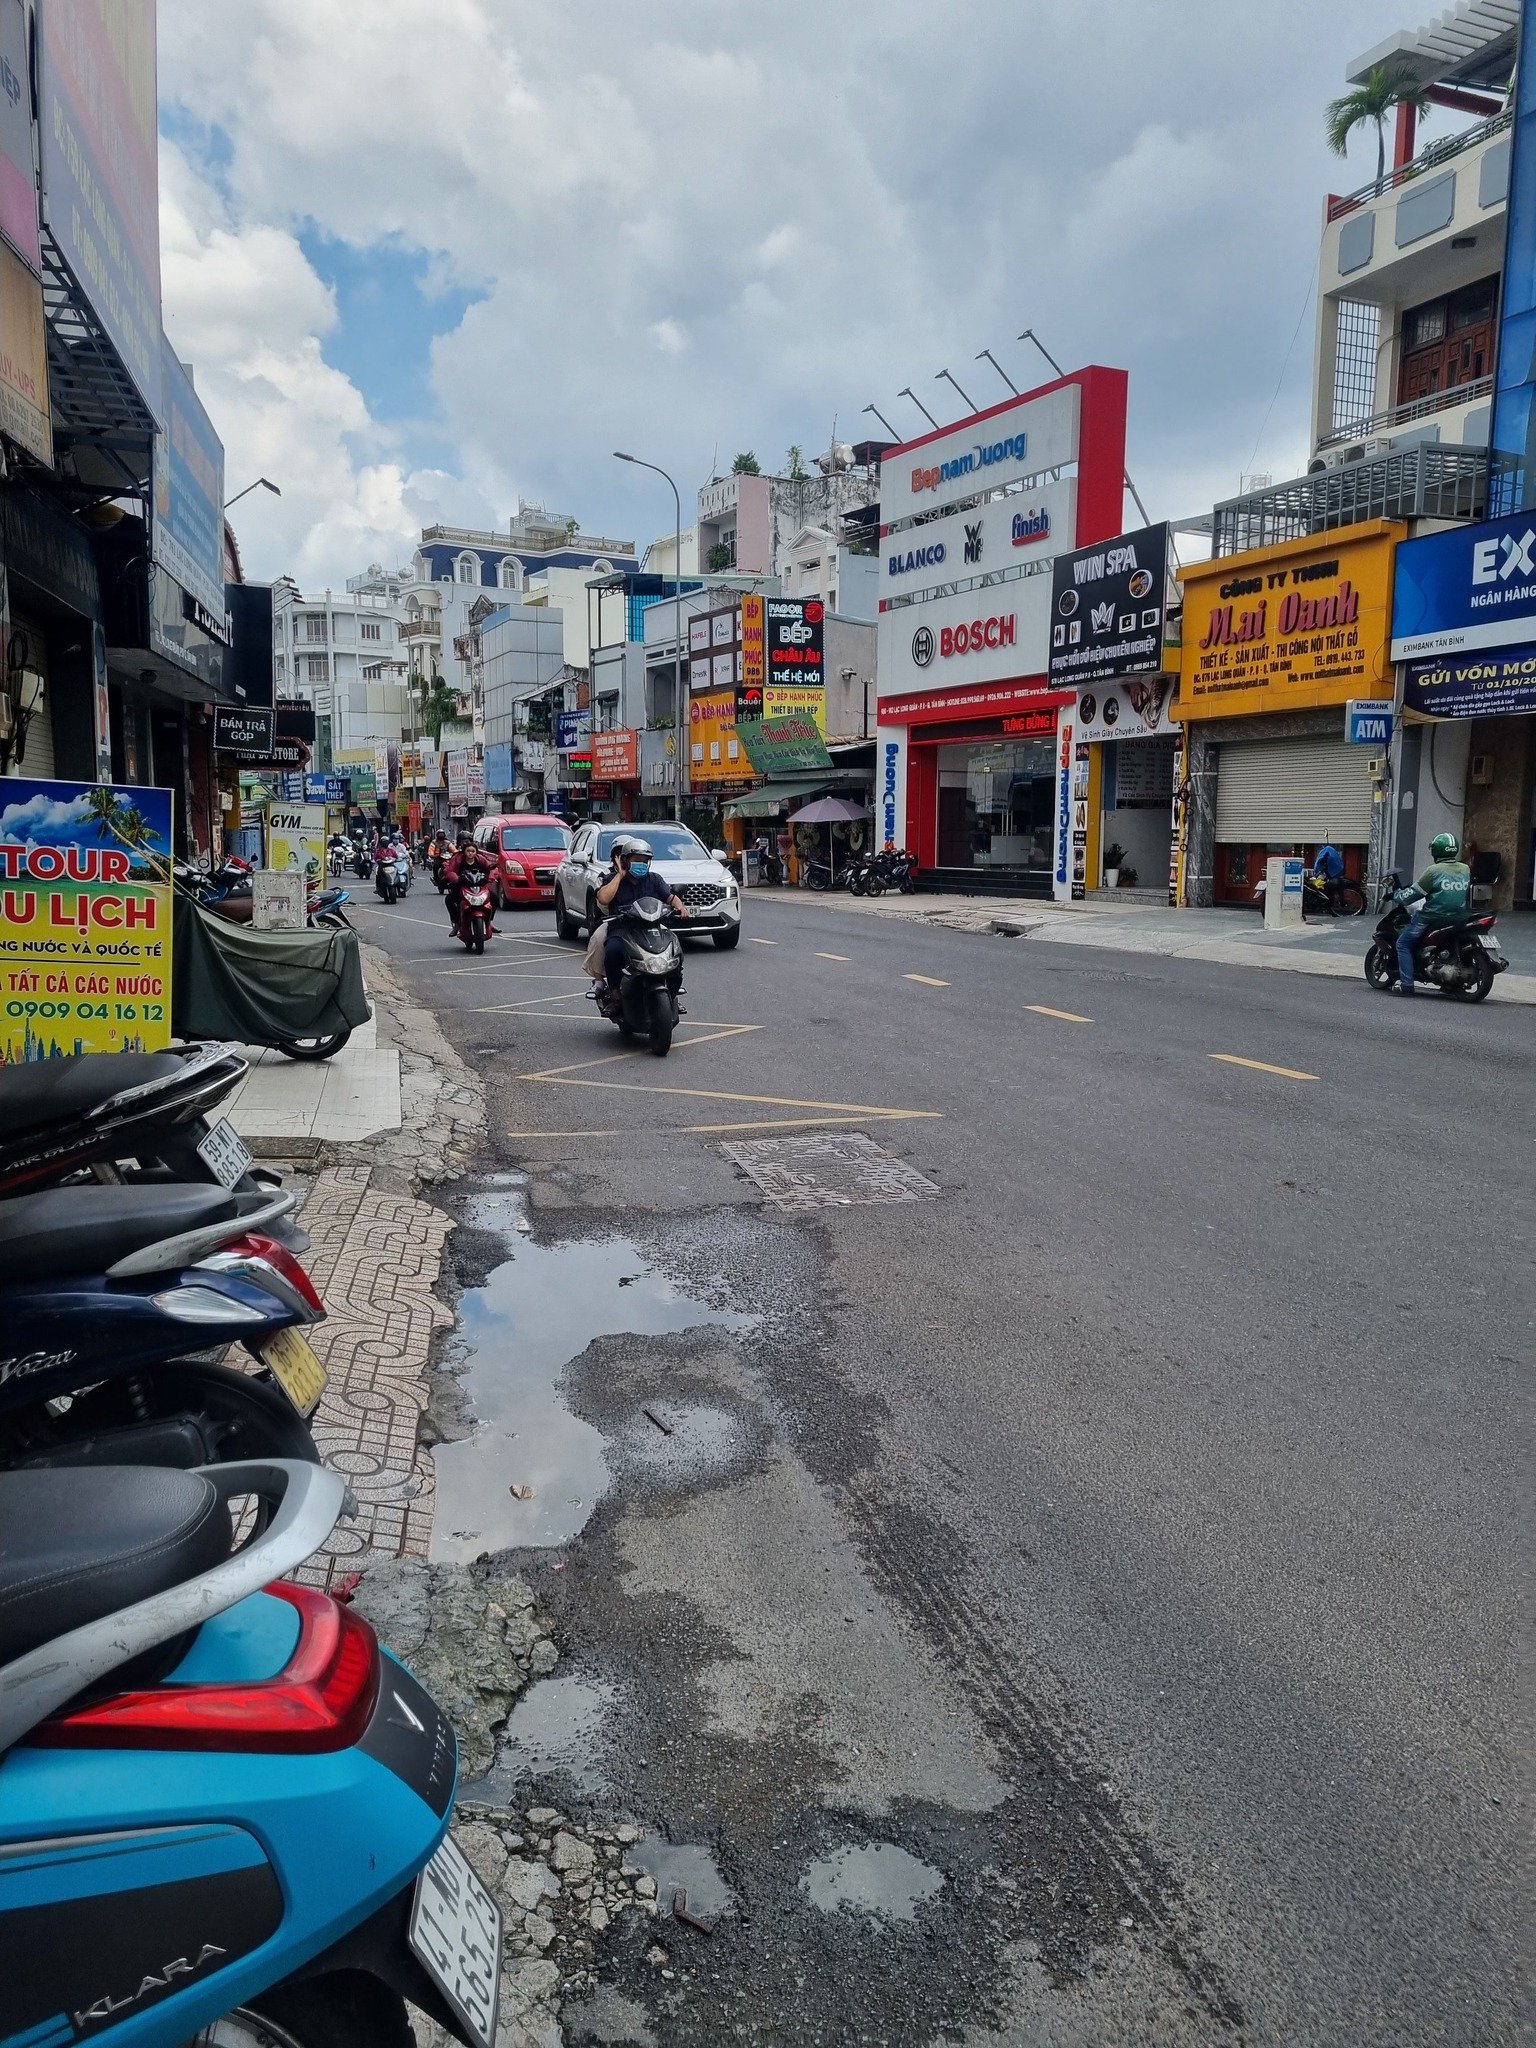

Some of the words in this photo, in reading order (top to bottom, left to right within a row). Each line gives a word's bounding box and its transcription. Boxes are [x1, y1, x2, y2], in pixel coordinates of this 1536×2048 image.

[1012, 507, 1051, 540] finish
[889, 542, 946, 577] BLANCO
[1073, 553, 1106, 585] WIN
[1106, 544, 1138, 576] SPA
[1220, 577, 1263, 599] CÔNG
[1267, 571, 1288, 589] TY
[1291, 560, 1340, 584] TNHH
[1471, 591, 1501, 608] NGÂN
[1504, 585, 1536, 602] HÀNG
[747, 598, 758, 618] BẾP
[768, 604, 803, 614] FAGOR
[1279, 581, 1359, 636] Oanh
[744, 627, 762, 645] HẠNH
[779, 620, 812, 643] BẾP
[940, 613, 1018, 658] BOSCH
[1200, 652, 1217, 669] THIẾT
[1219, 649, 1229, 666] KẾ
[1235, 644, 1249, 664] SẢN
[1252, 642, 1269, 661] XUẤT
[1277, 643, 1287, 658] THI
[1289, 639, 1308, 656] CÔNG
[1311, 635, 1323, 654] NỘI
[1326, 630, 1345, 650] THẤT
[1347, 626, 1358, 647] GỖ
[1403, 640, 1434, 653] EXIMBANK
[1435, 637, 1447, 648] TÂN
[1449, 636, 1465, 646] BÌNH
[744, 647, 761, 664] PHÚC
[772, 647, 803, 663] CHÂU
[805, 648, 820, 663] ÂU
[1354, 649, 1365, 660] 733
[773, 669, 790, 682] THẾ
[791, 670, 802, 683] HỆ
[804, 670, 820, 682] MỚI
[1211, 671, 1219, 682] LẠC
[1220, 669, 1232, 680] LONG
[1233, 666, 1245, 678] QUÂN
[1418, 669, 1451, 687] GỬI
[1455, 662, 1497, 681] VỐN
[1471, 682, 1485, 690] Từ
[777, 690, 788, 701] BẾP
[789, 692, 805, 703] HẠNH
[807, 691, 822, 701] PHÚC
[771, 702, 786, 714] THIẾT
[220, 717, 243, 729] BÁN
[246, 720, 266, 732] TRẢ
[1089, 730, 1100, 739] Sinh
[1102, 729, 1113, 738] Giày
[1114, 726, 1135, 737] Chuyên
[1136, 725, 1147, 733] Sâu
[1356, 720, 1386, 738] ATM
[230, 729, 254, 741] GÓP
[272, 747, 299, 760] STORE
[328, 780, 341, 790] SẮT
[327, 790, 344, 799] THÉP
[270, 814, 301, 829] GYM
[4, 845, 130, 884] TOUR
[49, 892, 157, 936] LỊCH
[23, 939, 67, 954] NƯỚC
[73, 940, 92, 954] VÀ
[96, 941, 140, 956] QUỐC
[145, 941, 162, 956] TẾ
[8, 968, 40, 992] TẤT
[46, 970, 68, 993] CẢ
[75, 973, 109, 995] CÁC
[116, 973, 163, 996] NƯỚC
[5, 1001, 70, 1020] 0909
[77, 1002, 108, 1020] 04
[115, 1003, 136, 1020] 16
[142, 1003, 163, 1020] 12
[204, 1126, 233, 1163] 59-N1
[217, 1142, 249, 1187] 885.18
[455, 1872, 496, 2035] 565.25
[75, 1944, 227, 2027] KLARA
